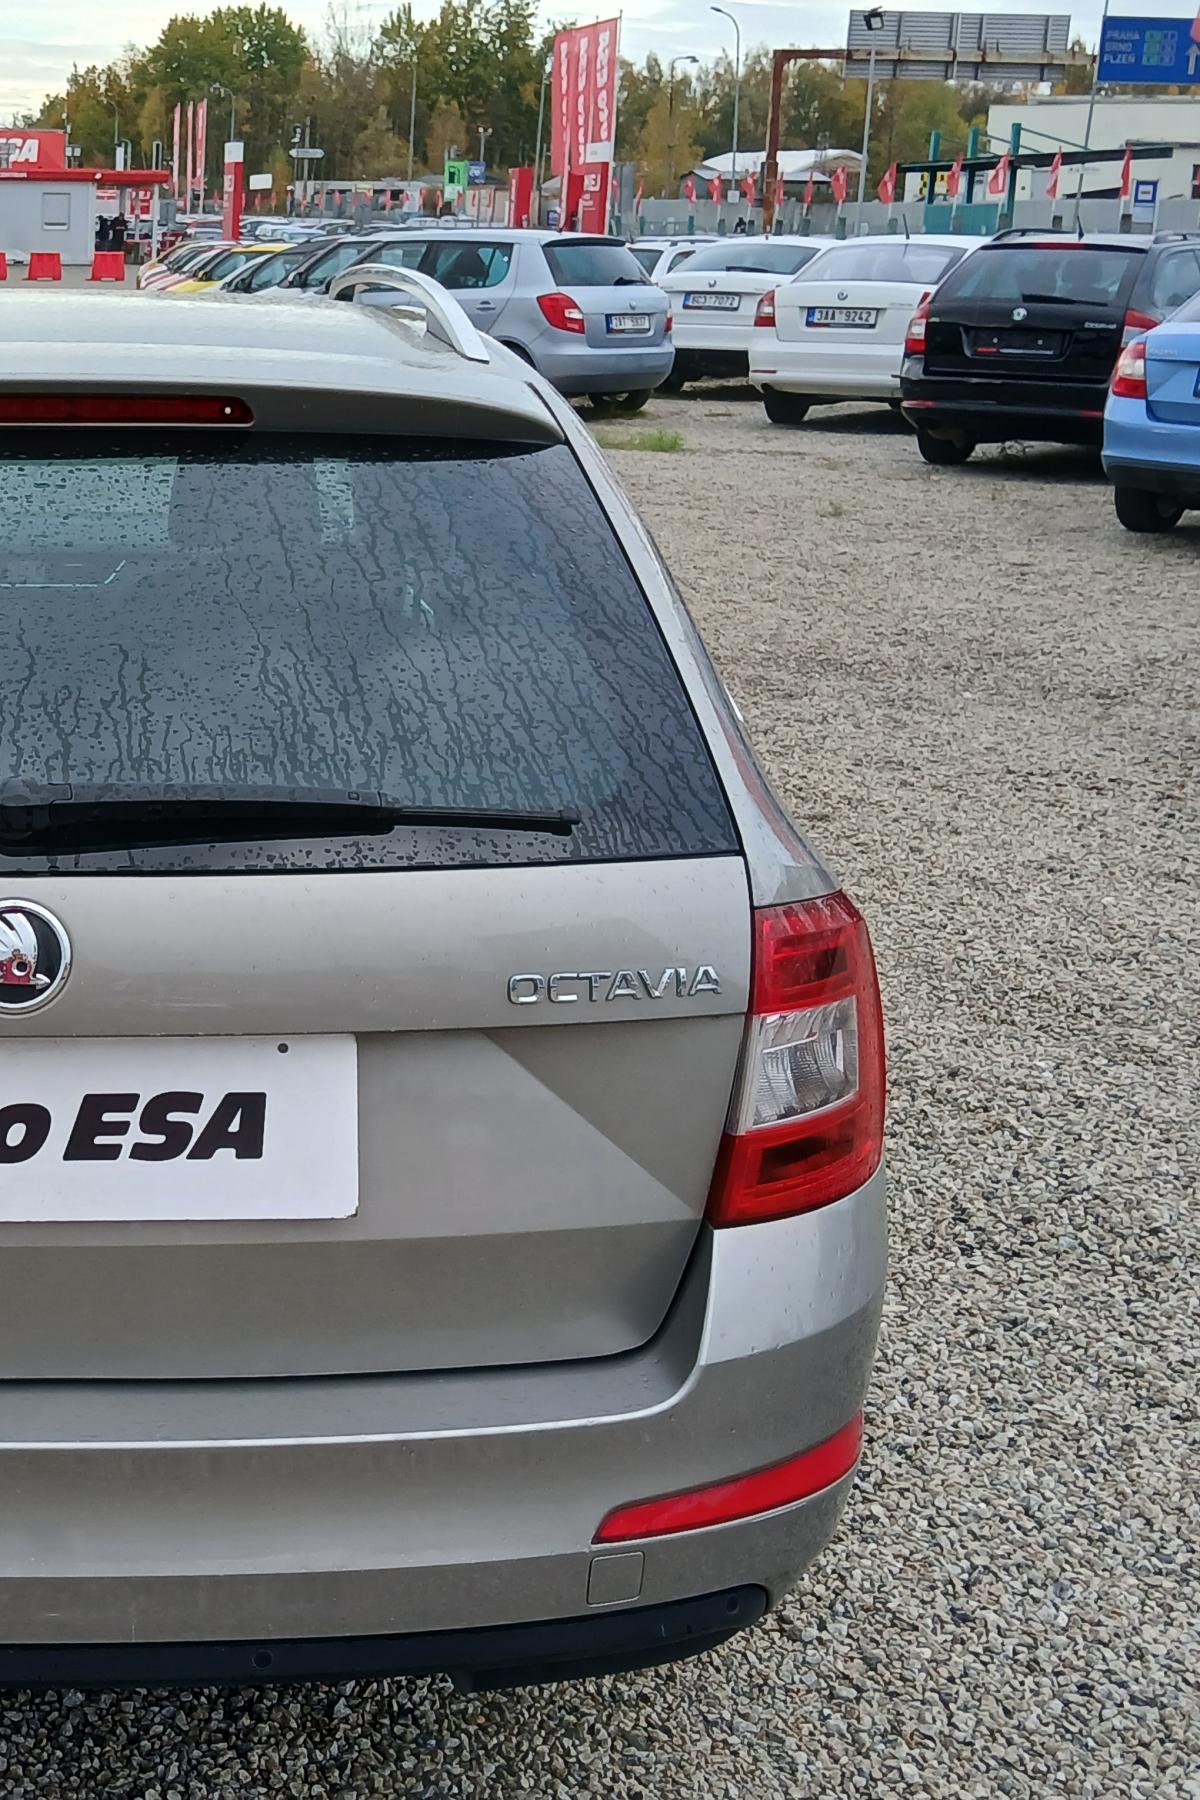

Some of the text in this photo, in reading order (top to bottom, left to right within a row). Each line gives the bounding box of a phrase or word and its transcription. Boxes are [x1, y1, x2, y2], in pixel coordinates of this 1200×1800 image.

[844, 310, 872, 323] 9242
[507, 965, 723, 1004] OCTAVIA
[62, 1091, 267, 1162] ESA
